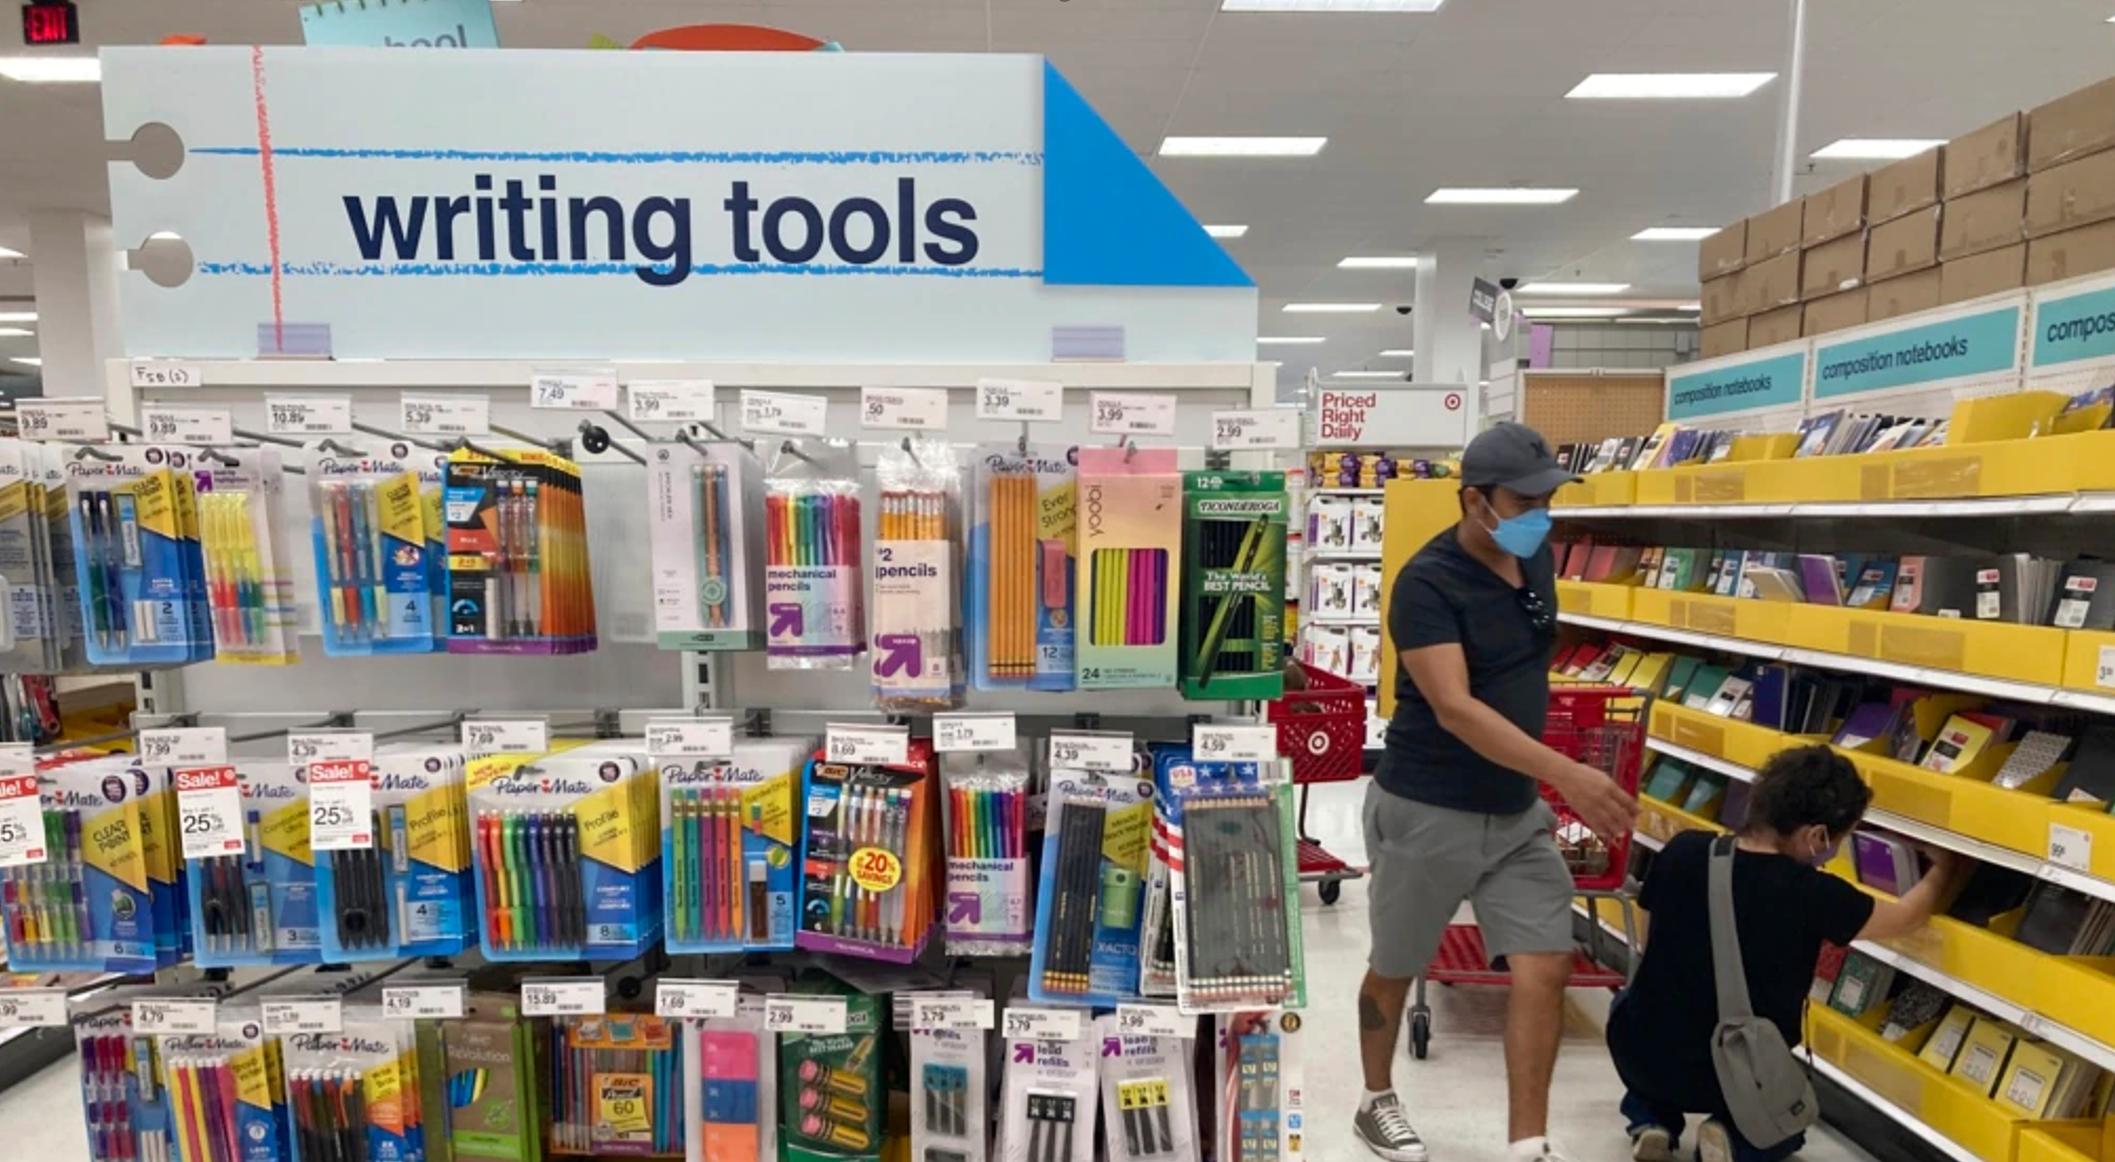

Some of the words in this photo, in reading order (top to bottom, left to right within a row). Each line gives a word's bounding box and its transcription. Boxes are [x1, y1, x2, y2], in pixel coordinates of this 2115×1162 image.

[343, 175, 692, 286] writing
[726, 178, 980, 264] tools
[1821, 350, 1892, 383] composition
[1895, 335, 1968, 368] notebooks
[539, 387, 565, 400] 7.49
[1673, 383, 1722, 407] composition
[1722, 373, 1773, 396] notebooks
[634, 399, 660, 412] 3.99
[1321, 392, 1376, 408] Priced
[272, 411, 305, 425] 10.89
[405, 411, 432, 424] 5.39
[1097, 408, 1124, 421] 3.99
[1321, 408, 1366, 426] Right
[21, 415, 49, 430] 9.89
[150, 420, 177, 435] 9.89
[1216, 426, 1243, 438] 2.99
[1321, 424, 1362, 441] Daily
[66, 462, 104, 478] Paper
[113, 464, 145, 477] Mate
[318, 458, 362, 475] Paper
[371, 461, 405, 474] Mate
[985, 455, 1028, 473] Paper
[1035, 458, 1067, 473] Mate
[1087, 484, 1104, 538] yoobi
[1199, 500, 1281, 513] TICONDEROGA
[767, 567, 837, 580] mechanical
[878, 563, 938, 579] pencils
[1206, 570, 1228, 582] The
[767, 580, 812, 593] pencils
[1203, 580, 1231, 592] BEST
[1231, 580, 1272, 592] PENCIL
[1043, 646, 1058, 659] 12
[1081, 668, 1100, 680] 24
[1054, 749, 1079, 760] 4.39
[178, 771, 221, 789] Sale!
[311, 765, 354, 781] Sale!
[661, 764, 714, 784] Paper
[722, 766, 765, 783] Mate
[379, 773, 430, 789] Mate
[490, 776, 539, 797] Paper
[550, 780, 592, 795] Mate
[1058, 779, 1097, 796] Paper
[251, 783, 295, 798] Mate
[63, 790, 103, 807] Mate
[184, 814, 210, 833] 25
[314, 807, 341, 825] 25
[409, 806, 447, 830] Profile
[864, 852, 888, 873] 20
[948, 860, 1014, 872] mechanical
[856, 870, 893, 885] SAVINGS
[948, 873, 989, 883] pencils
[526, 994, 556, 1005] 15.89
[660, 997, 685, 1008] 1.69
[72, 1013, 121, 1029] Paper
[768, 1012, 793, 1024] 2.99
[921, 1011, 945, 1023] 3.79
[1120, 1015, 1144, 1028] 3.99
[165, 1037, 205, 1051] Paper
[289, 1033, 340, 1053] Paper
[350, 1037, 390, 1054] Mate
[1124, 1043, 1158, 1056] refills
[1036, 1056, 1070, 1068] refills
[611, 1077, 640, 1087] BIC
[613, 1101, 634, 1116] 60
